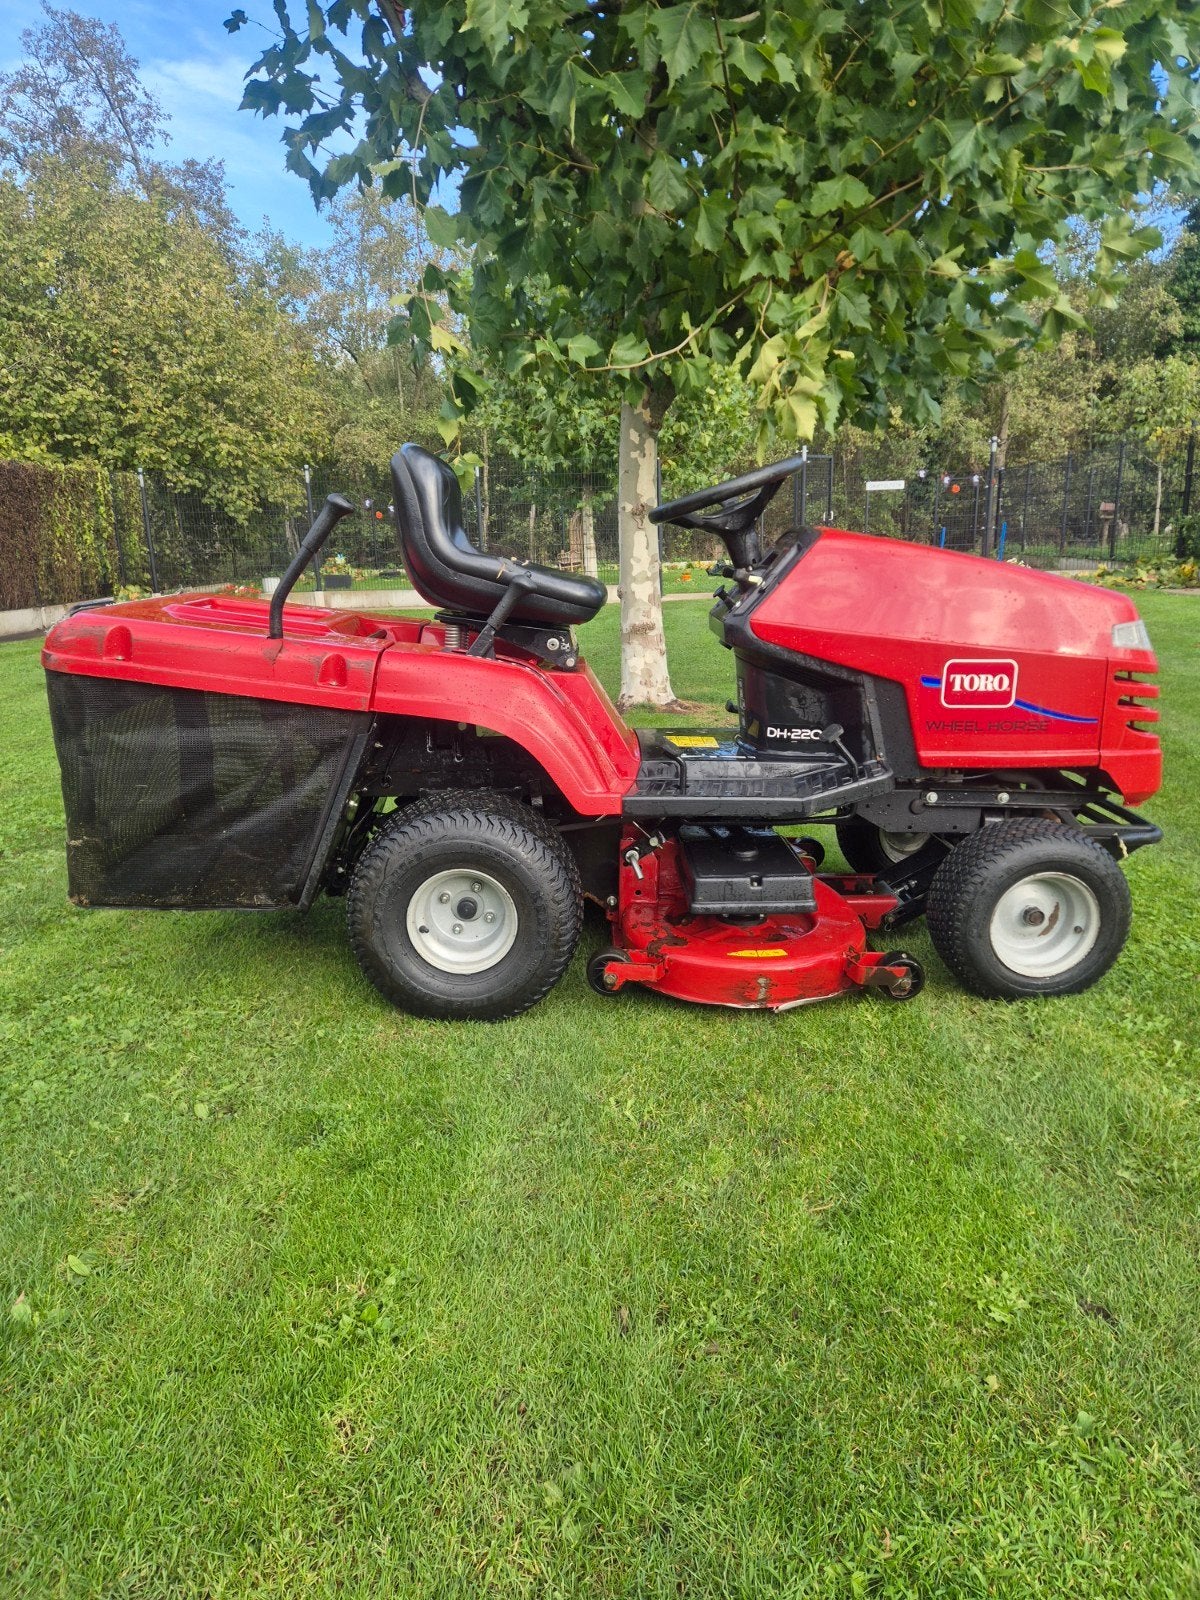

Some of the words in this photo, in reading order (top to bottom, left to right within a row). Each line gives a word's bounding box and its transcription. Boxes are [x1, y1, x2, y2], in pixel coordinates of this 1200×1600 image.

[950, 673, 1010, 692] TORO
[925, 720, 984, 732] WHEEL
[987, 720, 1049, 732] HORSE
